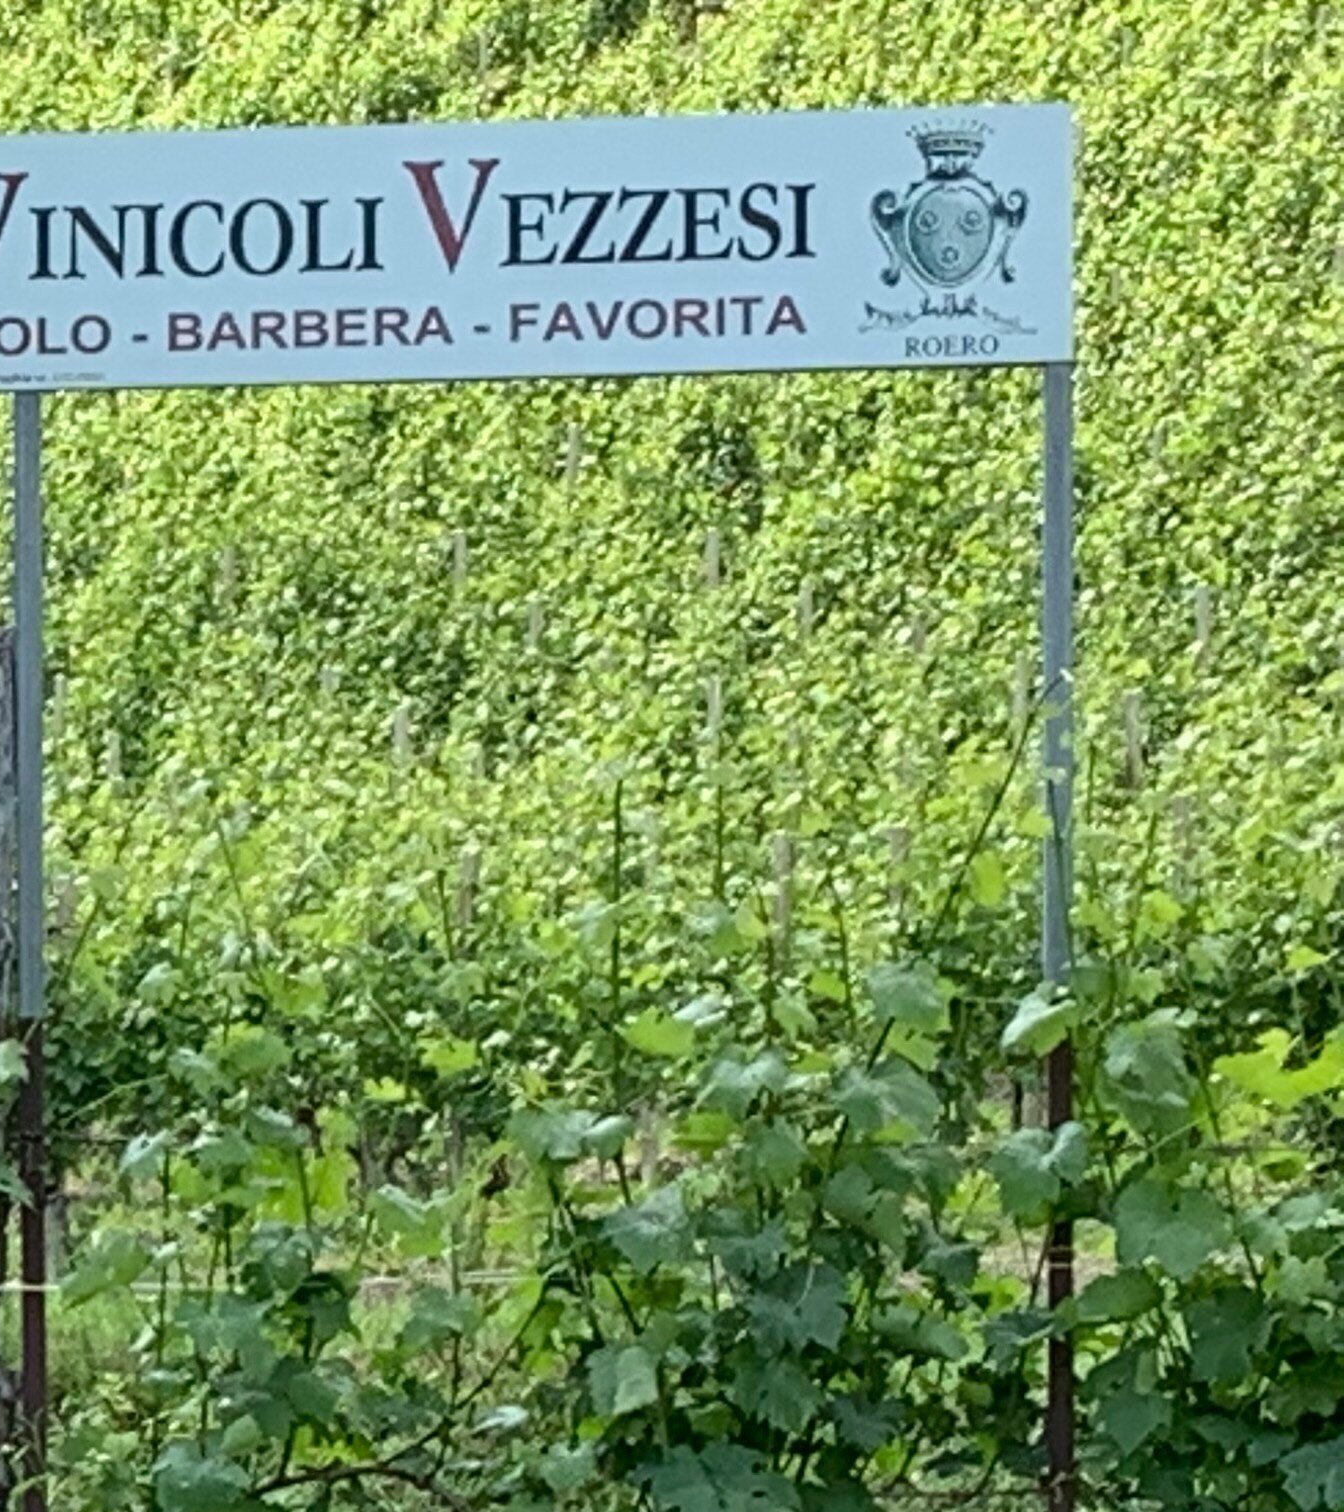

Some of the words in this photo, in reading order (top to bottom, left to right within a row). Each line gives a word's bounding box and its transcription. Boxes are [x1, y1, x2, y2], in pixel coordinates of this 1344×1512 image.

[402, 157, 818, 275] VEZZESI
[167, 305, 455, 353] BARBERA
[509, 295, 808, 343] FAVORITA
[904, 333, 999, 357] ROERO
